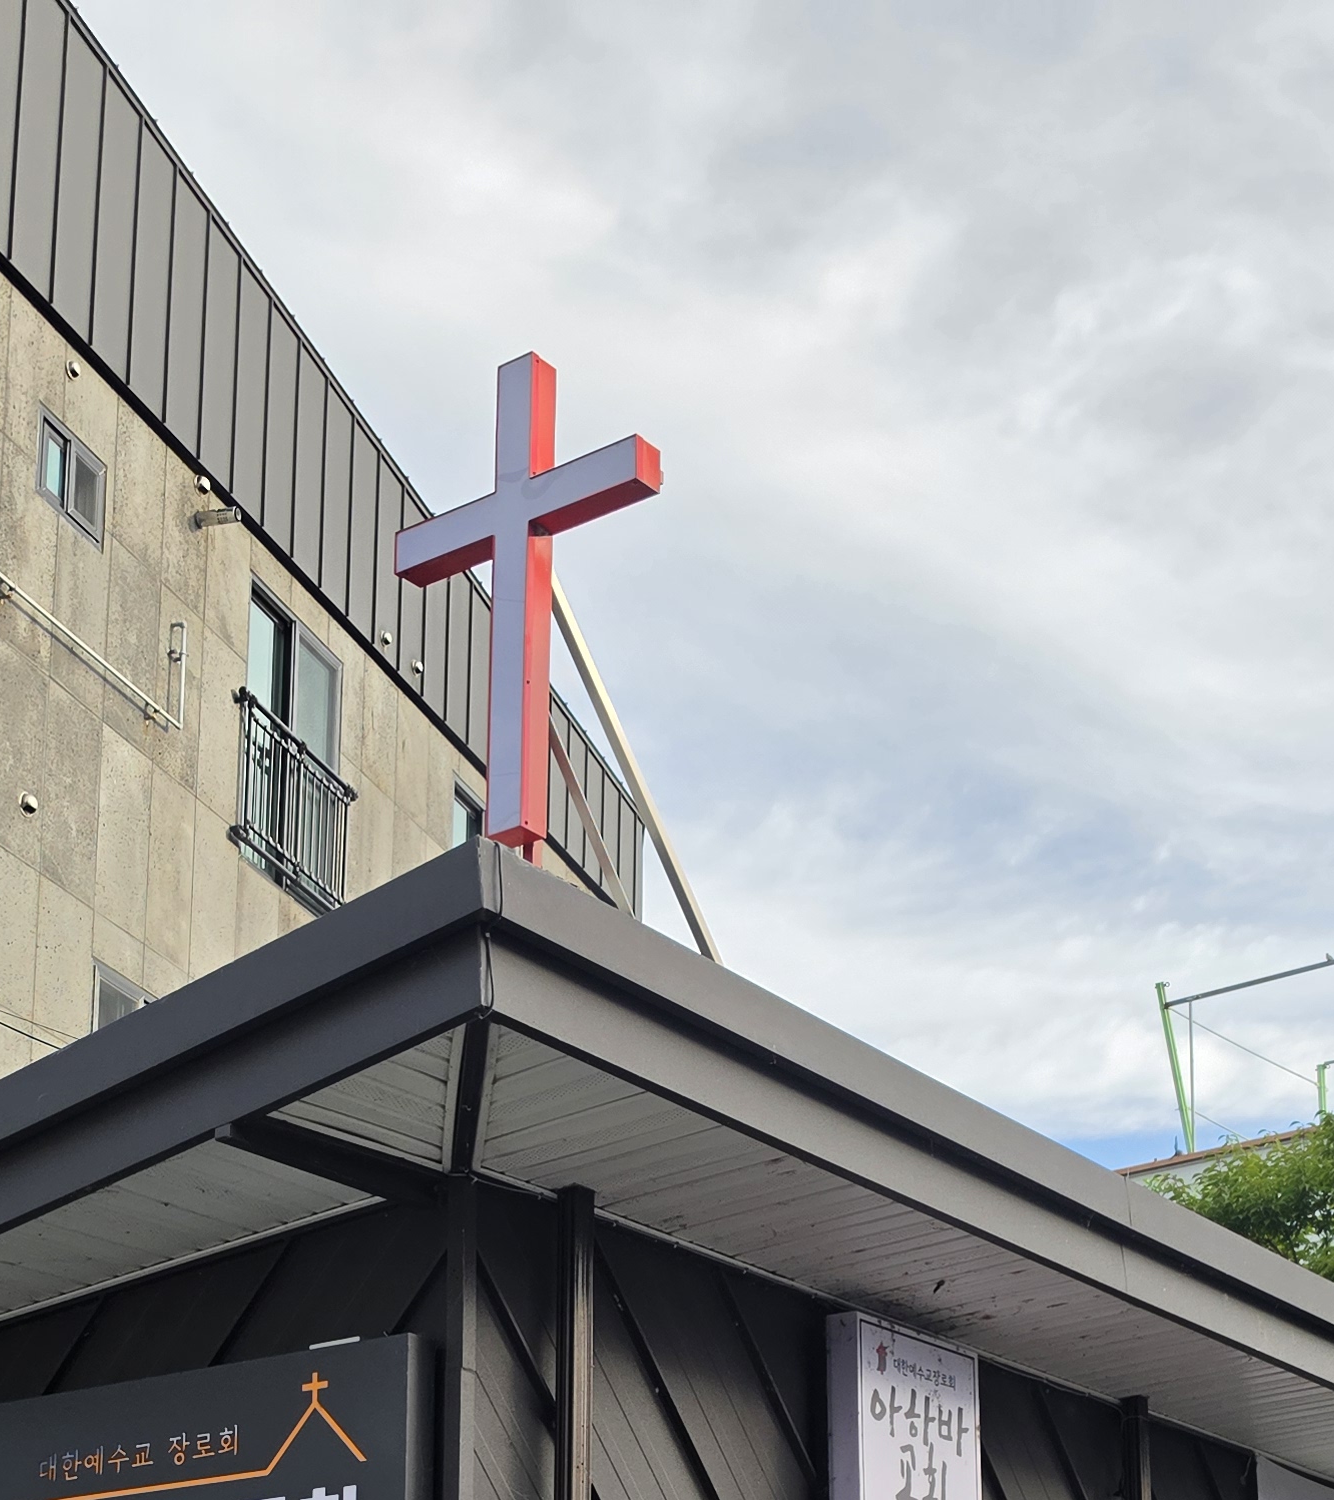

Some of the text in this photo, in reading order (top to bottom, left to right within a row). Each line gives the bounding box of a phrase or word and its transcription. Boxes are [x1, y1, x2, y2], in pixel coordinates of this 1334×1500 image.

[38, 1424, 239, 1482] 대한예수교 장로회
[870, 1385, 969, 1457] 아하바
